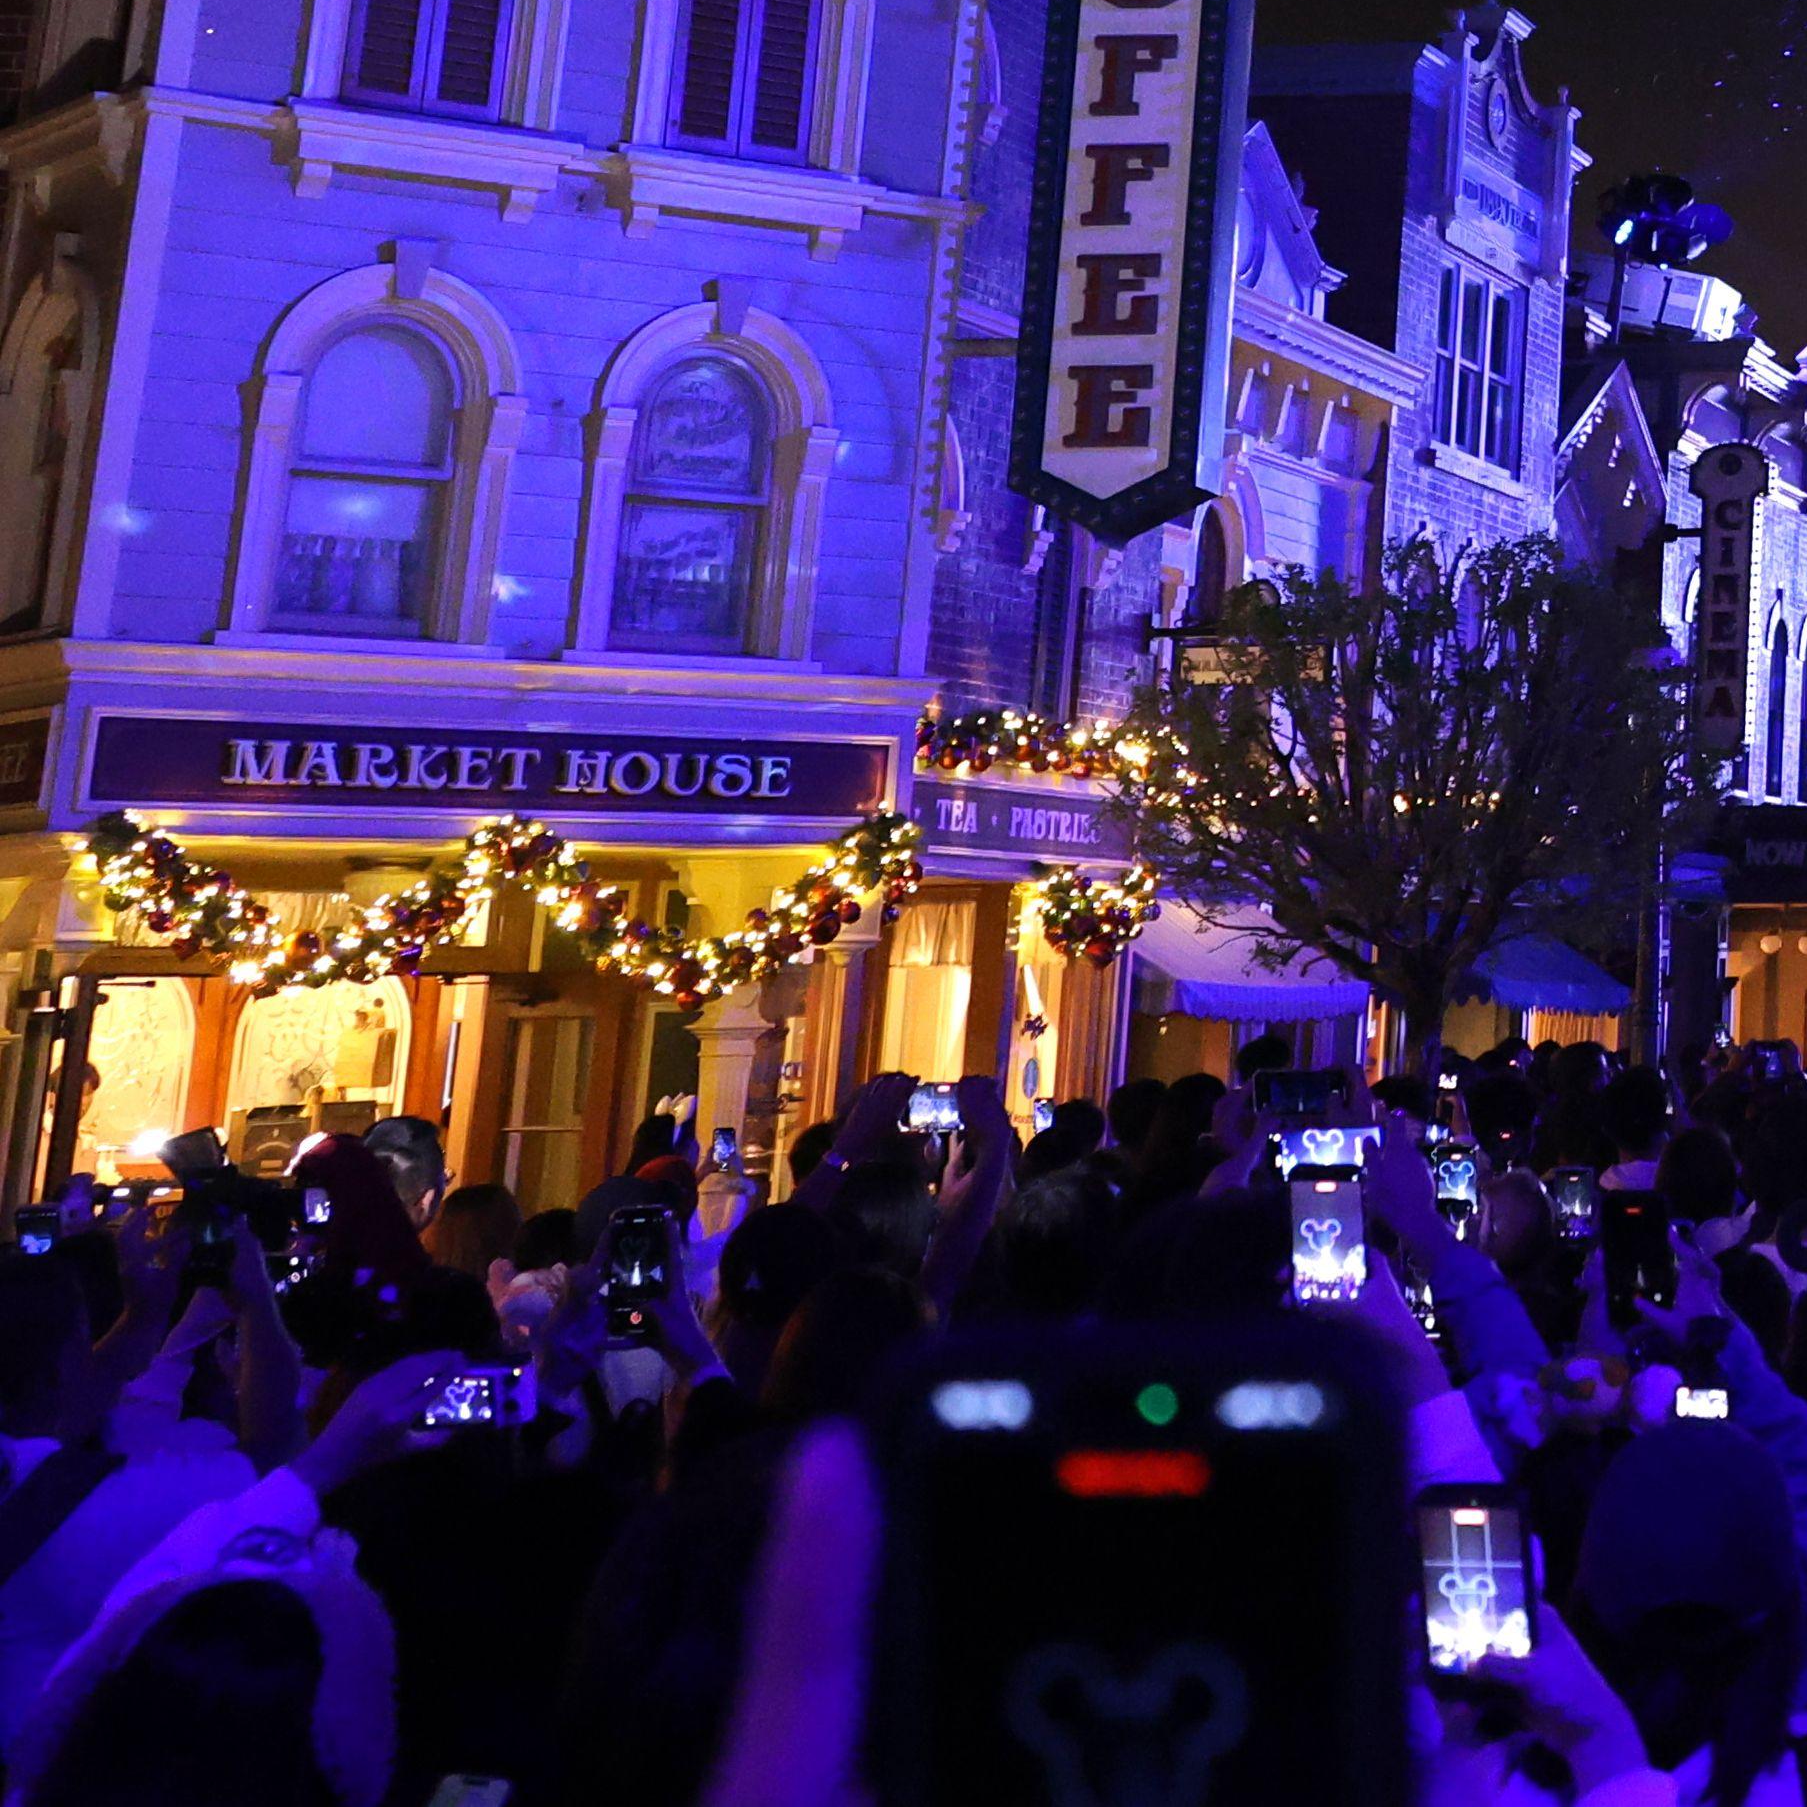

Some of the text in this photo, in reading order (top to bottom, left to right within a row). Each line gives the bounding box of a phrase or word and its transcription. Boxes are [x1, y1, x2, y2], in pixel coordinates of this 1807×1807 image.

[1704, 499, 1746, 718] CINEMA
[221, 739, 793, 798] MARKET HOUSE
[935, 798, 979, 834] TEA
